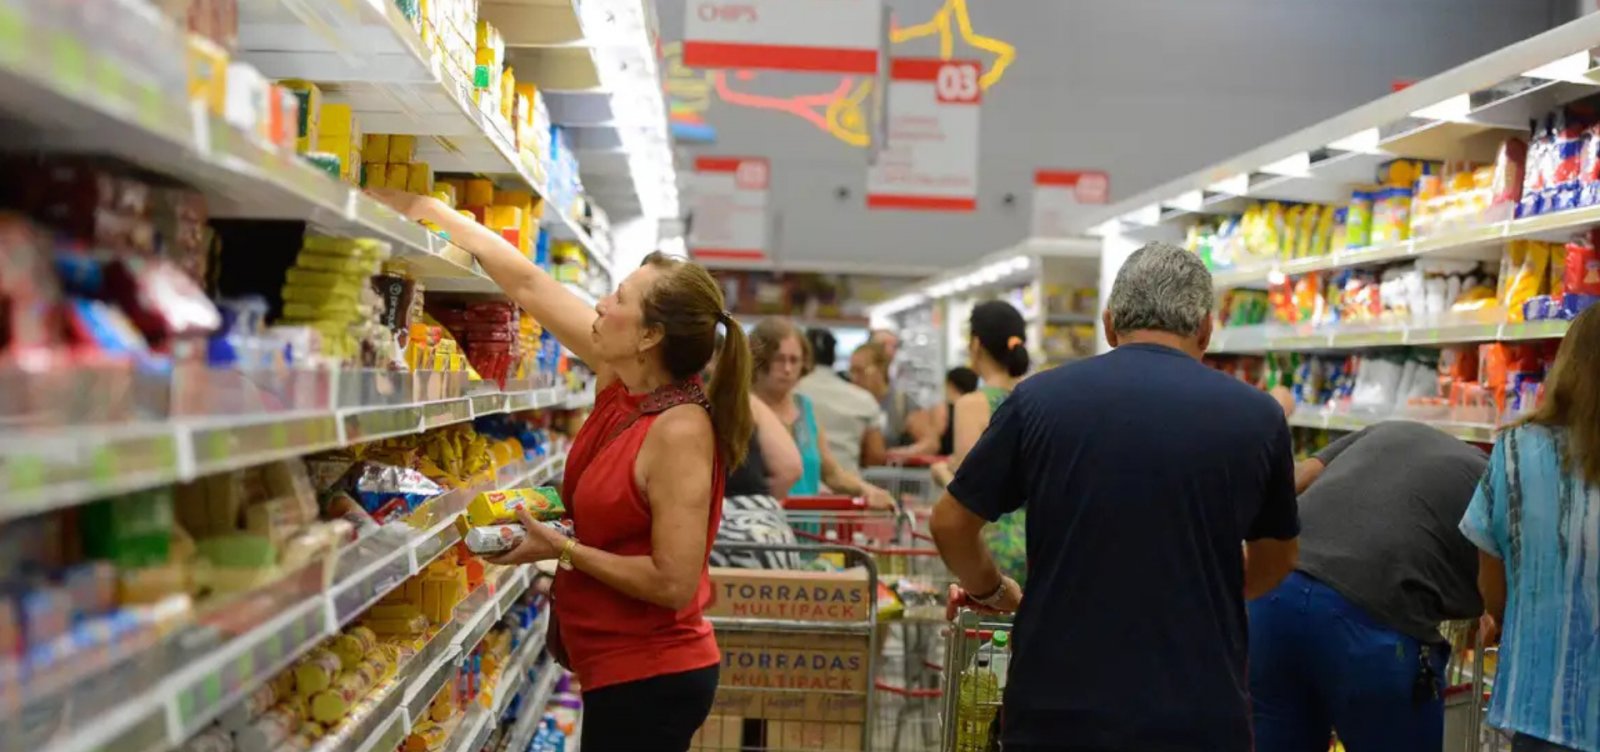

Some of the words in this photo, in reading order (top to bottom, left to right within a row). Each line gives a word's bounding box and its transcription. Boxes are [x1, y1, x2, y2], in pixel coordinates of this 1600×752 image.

[939, 64, 977, 99] 03
[724, 583, 862, 602] TORRADAS
[733, 602, 854, 617] MULTIPACK
[725, 651, 860, 670] TORRADAS
[732, 672, 852, 690] MULTIPACK
